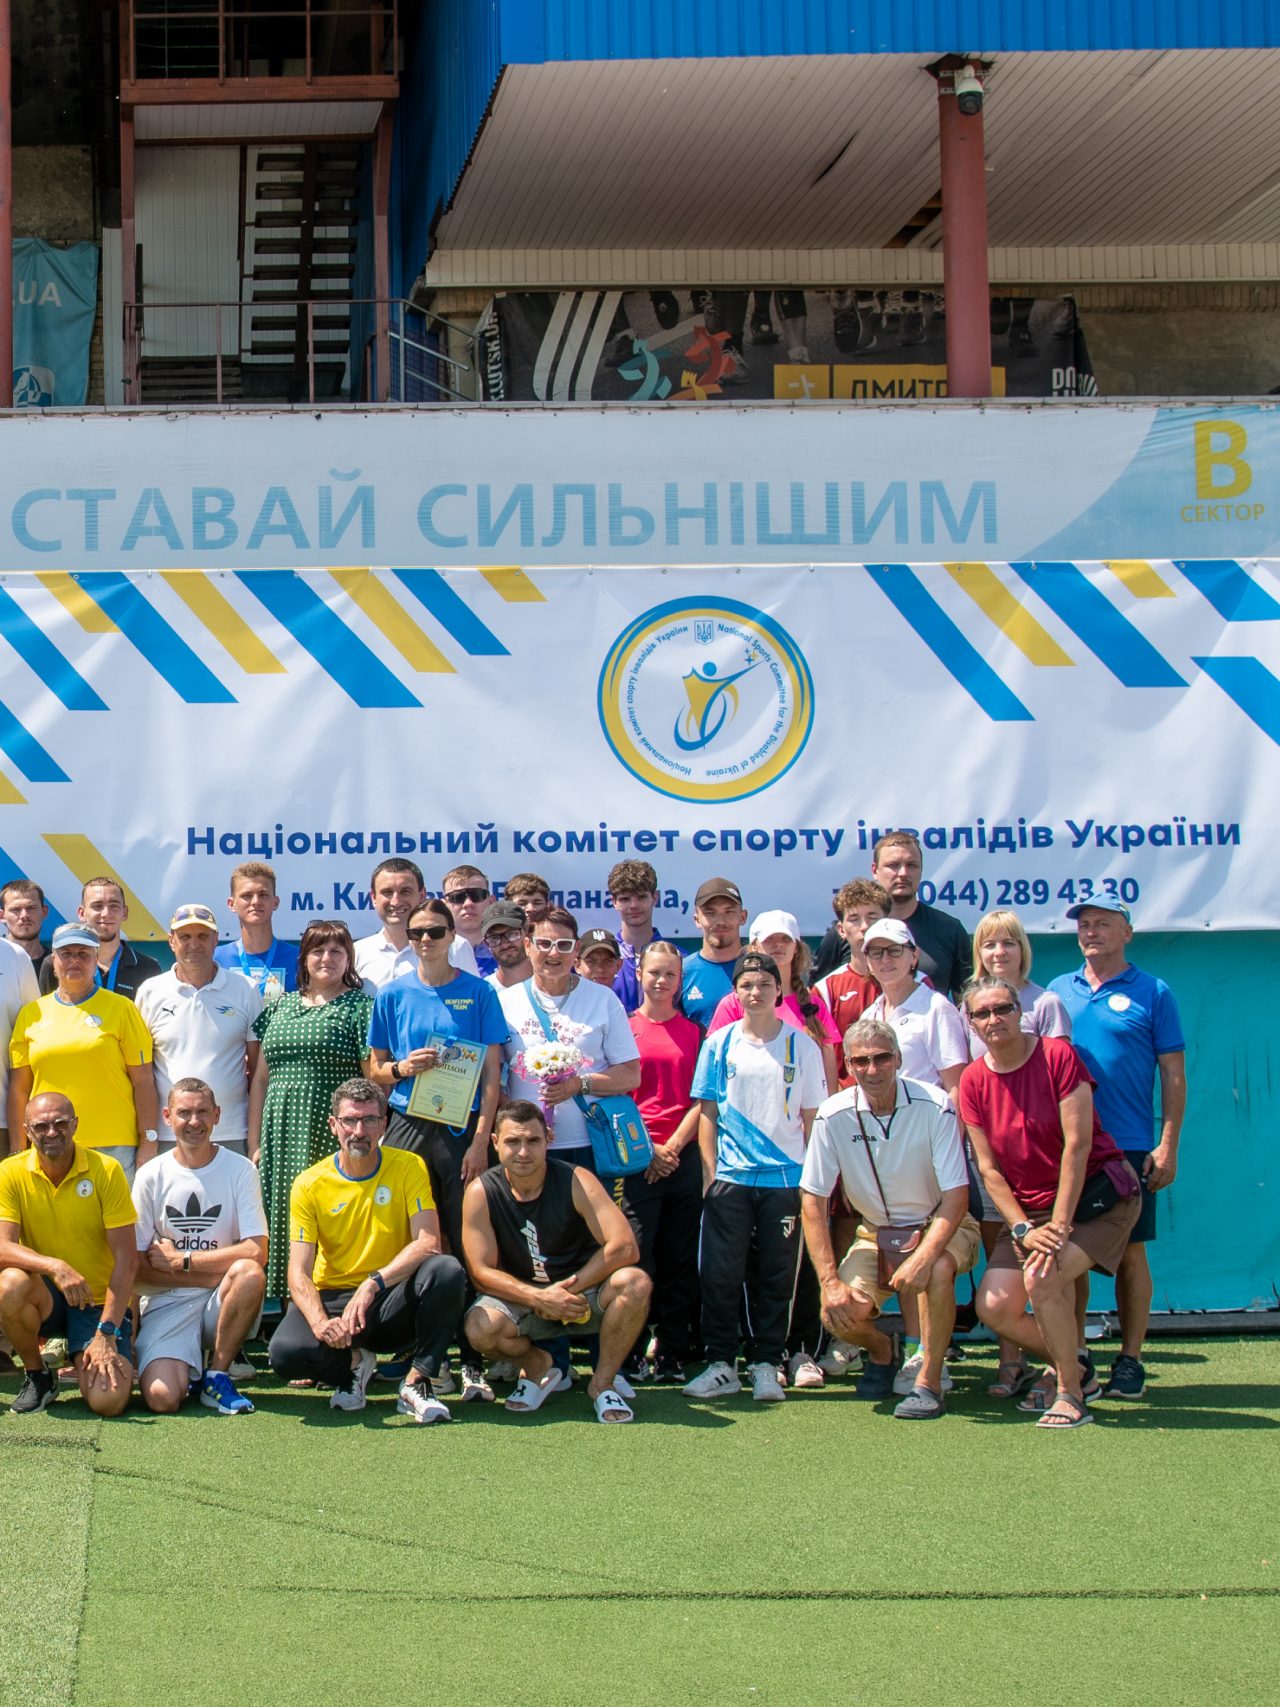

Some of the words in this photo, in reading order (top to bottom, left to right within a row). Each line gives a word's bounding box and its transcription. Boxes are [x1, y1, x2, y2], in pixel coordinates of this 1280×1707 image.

[11, 468, 376, 553] СТАВАЙ
[415, 480, 999, 549] СИЛЬНІШИМ
[1180, 503, 1266, 524] СЕКТОР
[655, 625, 689, 644] України
[717, 623, 753, 643] National
[751, 639, 771, 663] Sports
[769, 662, 786, 704] Committee
[780, 706, 788, 719] for
[774, 720, 784, 734] the
[753, 734, 778, 764] Disabled
[706, 764, 739, 777] Ukraine
[187, 822, 499, 859] Національний
[513, 822, 680, 854] комітет
[692, 825, 845, 857] спорту
[1064, 815, 1242, 853] України
[996, 879, 1050, 906] 289
[1057, 878, 1095, 904] 43
